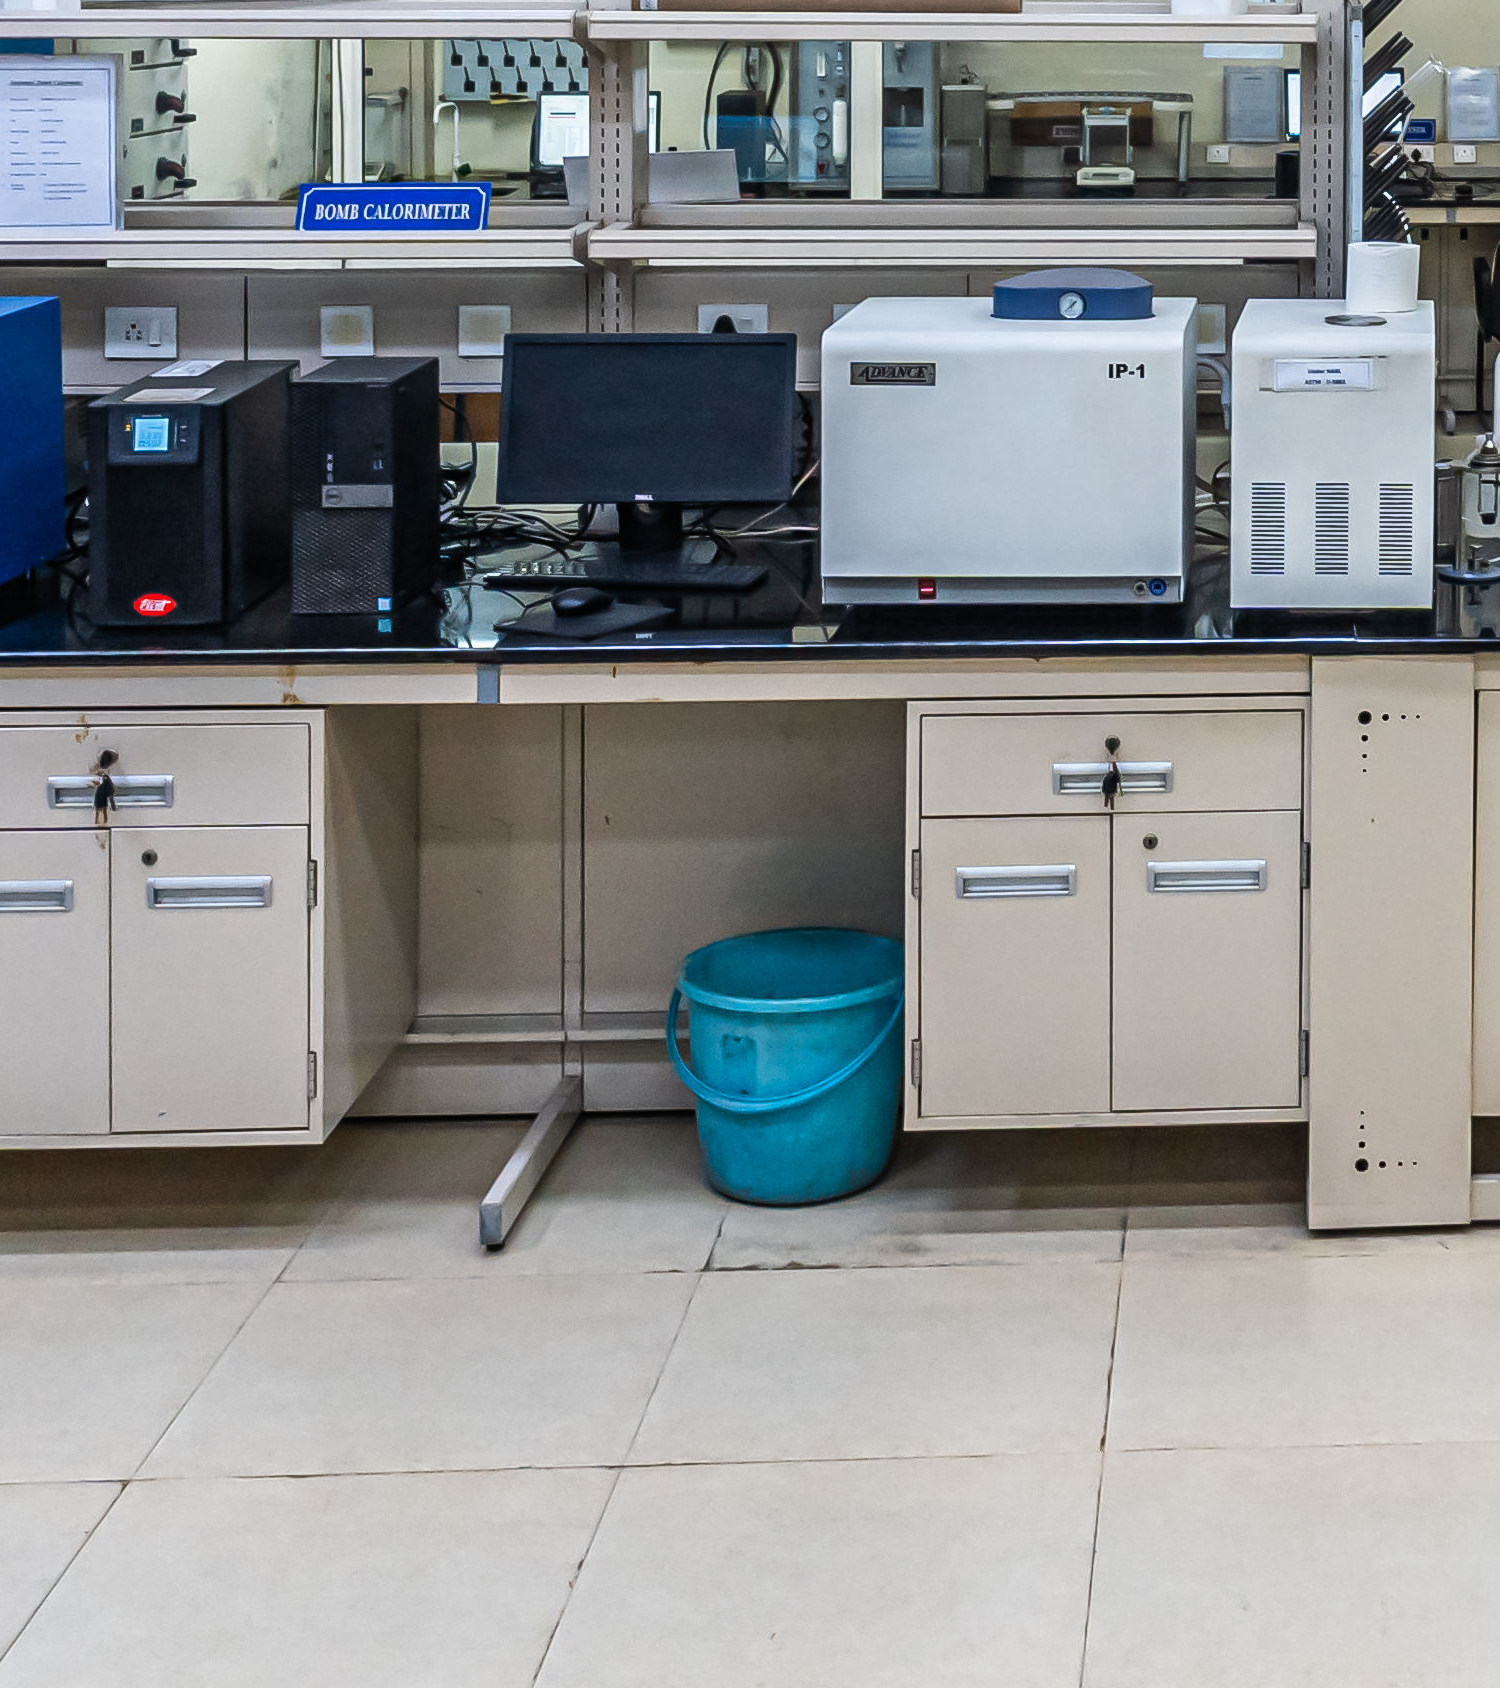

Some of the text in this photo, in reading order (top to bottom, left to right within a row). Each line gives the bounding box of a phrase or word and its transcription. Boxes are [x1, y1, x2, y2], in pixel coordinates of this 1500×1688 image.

[314, 203, 470, 220] BOMB CALORIMETER
[856, 365, 928, 382] ADVANCE
[1108, 363, 1145, 378] IP-1
